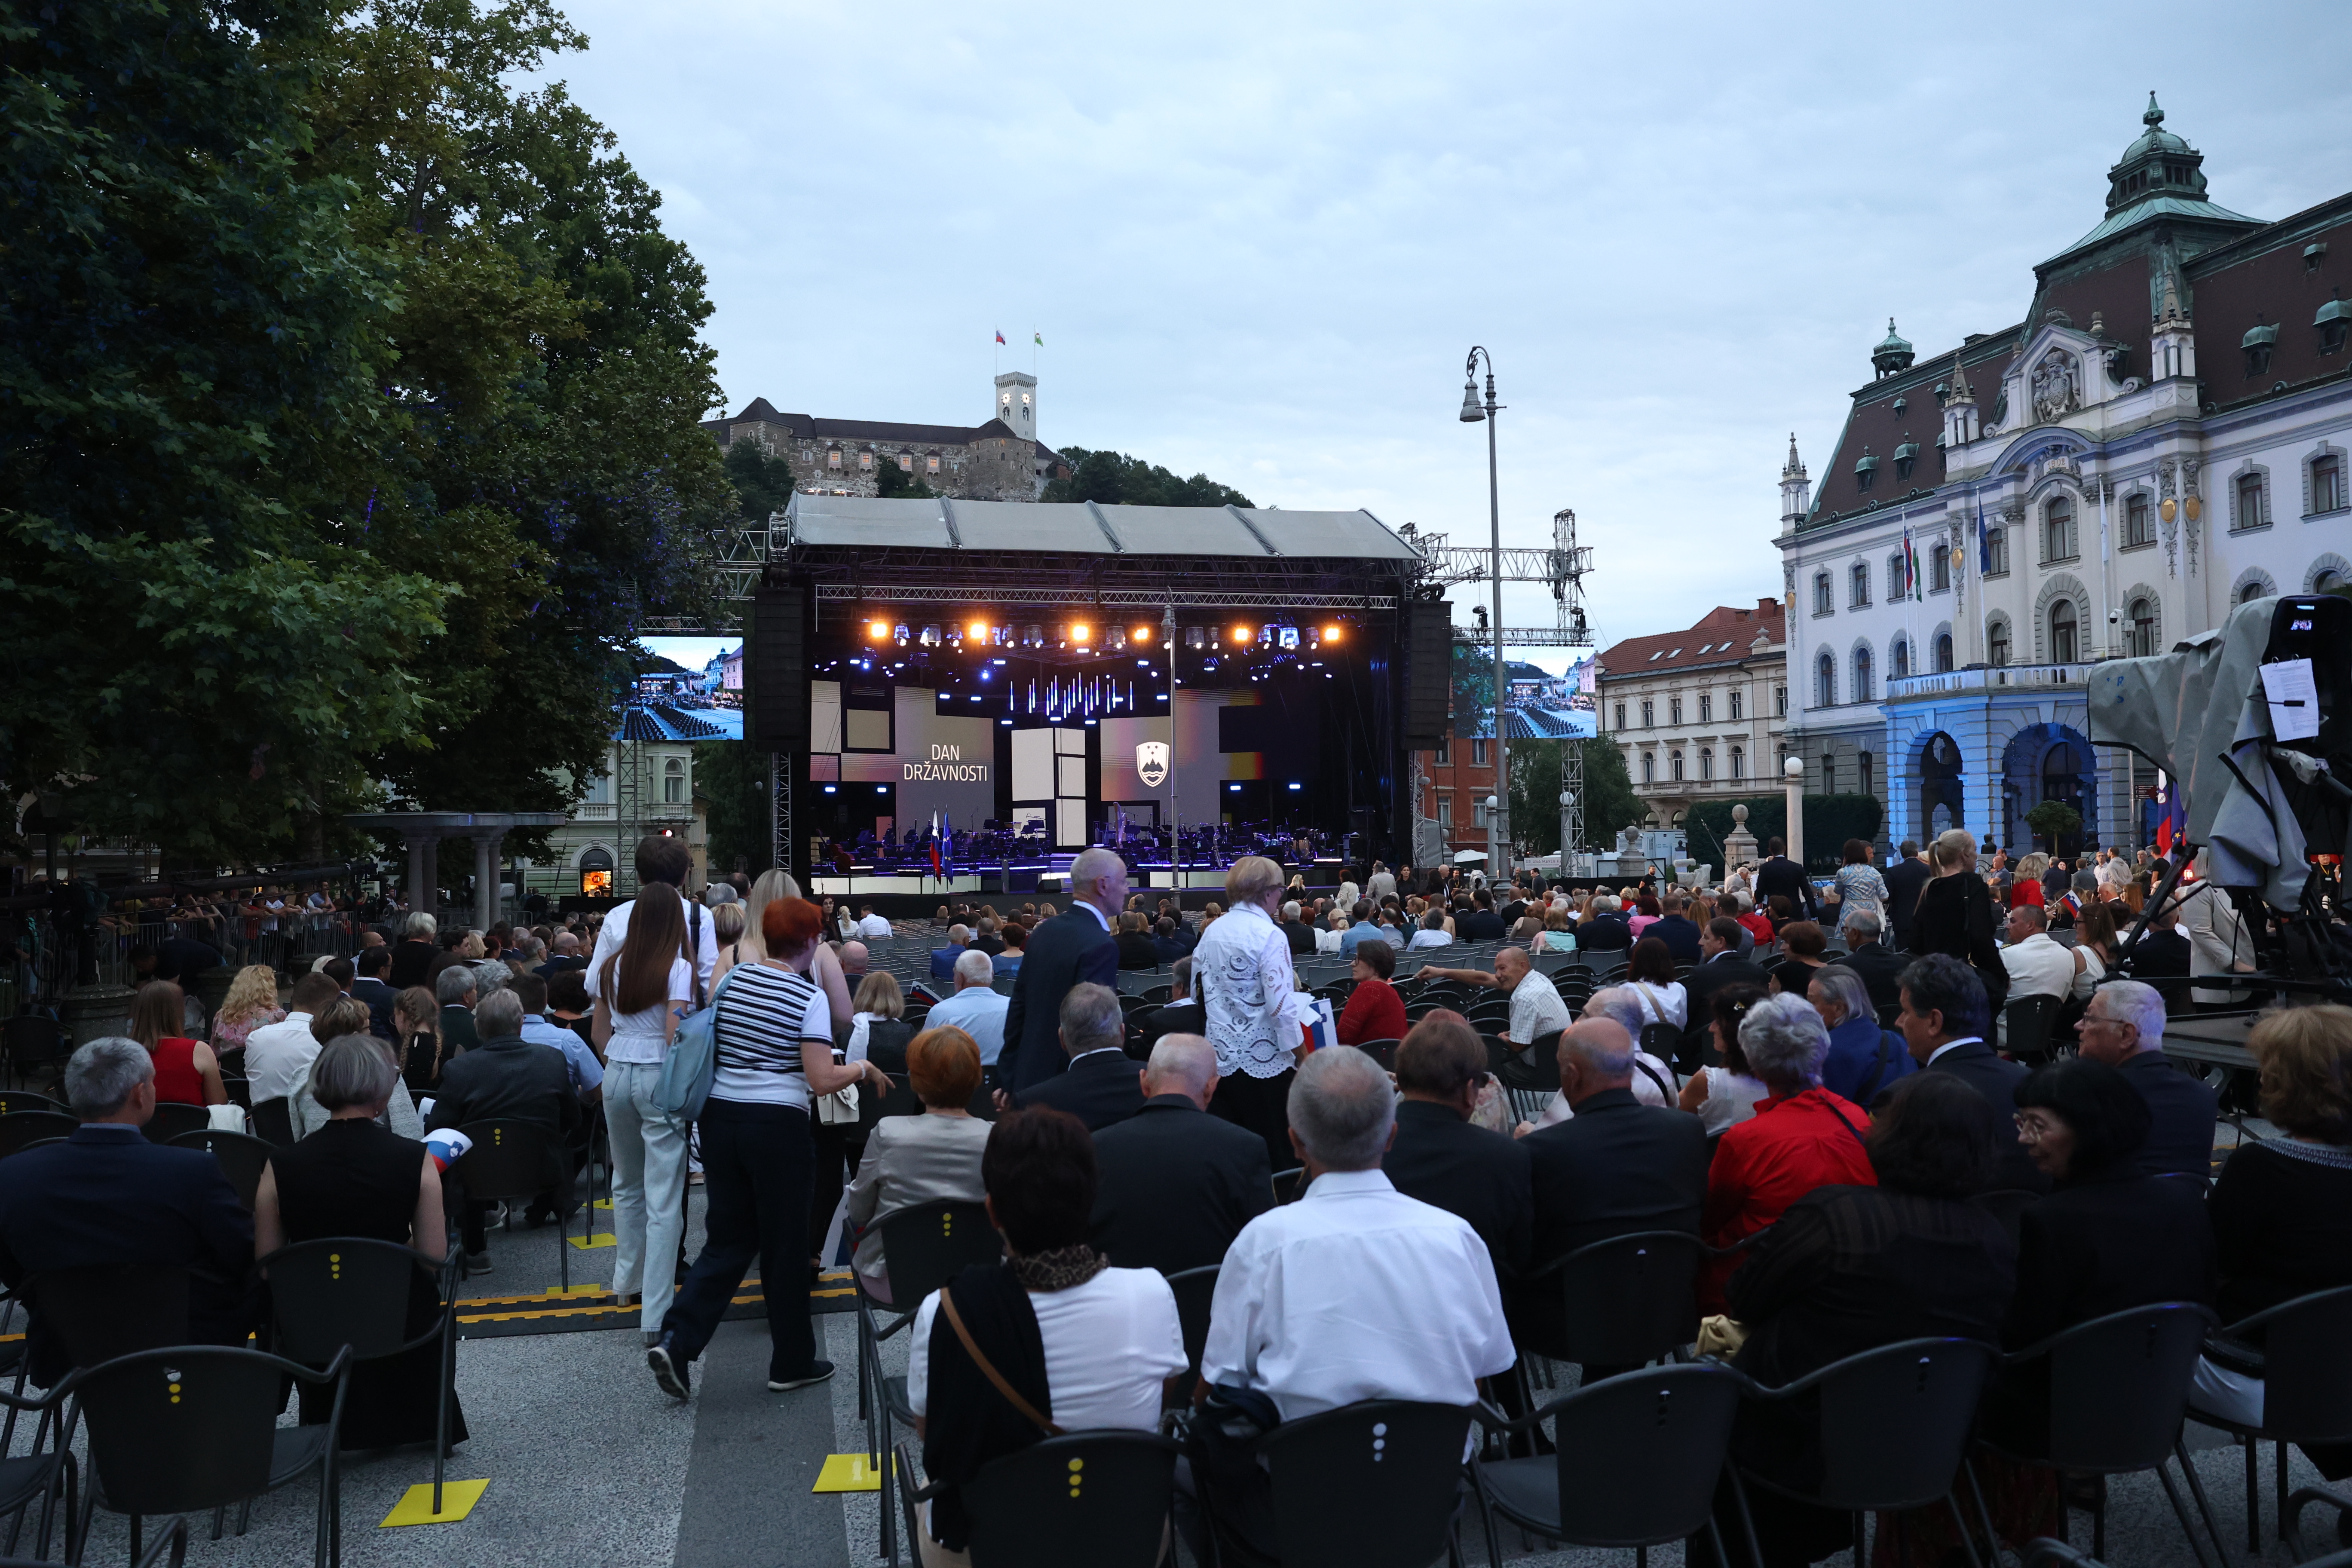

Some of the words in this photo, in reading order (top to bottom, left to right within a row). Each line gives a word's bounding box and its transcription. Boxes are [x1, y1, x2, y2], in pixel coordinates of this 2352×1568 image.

[2047, 457, 2065, 469] 1902
[932, 744, 959, 761] DAN
[904, 761, 987, 781] DRŽAVNOSTI
